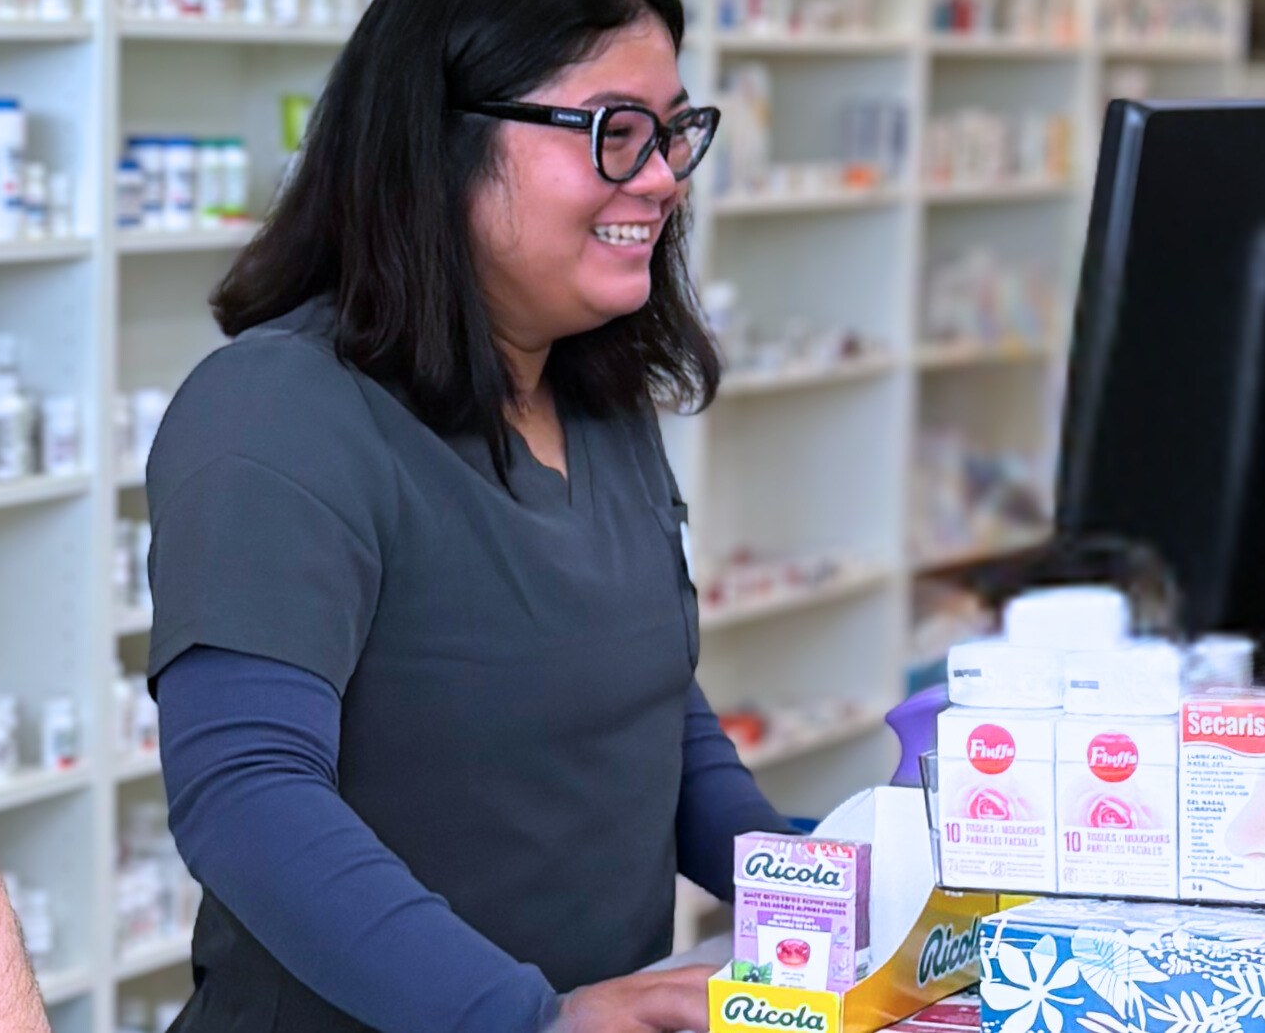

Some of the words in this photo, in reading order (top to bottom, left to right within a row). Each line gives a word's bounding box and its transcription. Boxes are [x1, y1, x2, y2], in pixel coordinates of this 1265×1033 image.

[1187, 711, 1265, 737] Secaris
[1089, 746, 1138, 768] Fluffs
[944, 822, 961, 844] 10
[966, 823, 995, 834] TISSUES
[1002, 825, 1047, 836] MOUCHOIRS
[1064, 831, 1082, 853] 10
[1087, 832, 1117, 843] TISSUES
[1124, 833, 1171, 845] MOUCHOIRS
[745, 852, 840, 886] Ricola
[724, 995, 825, 1031] Ricola
